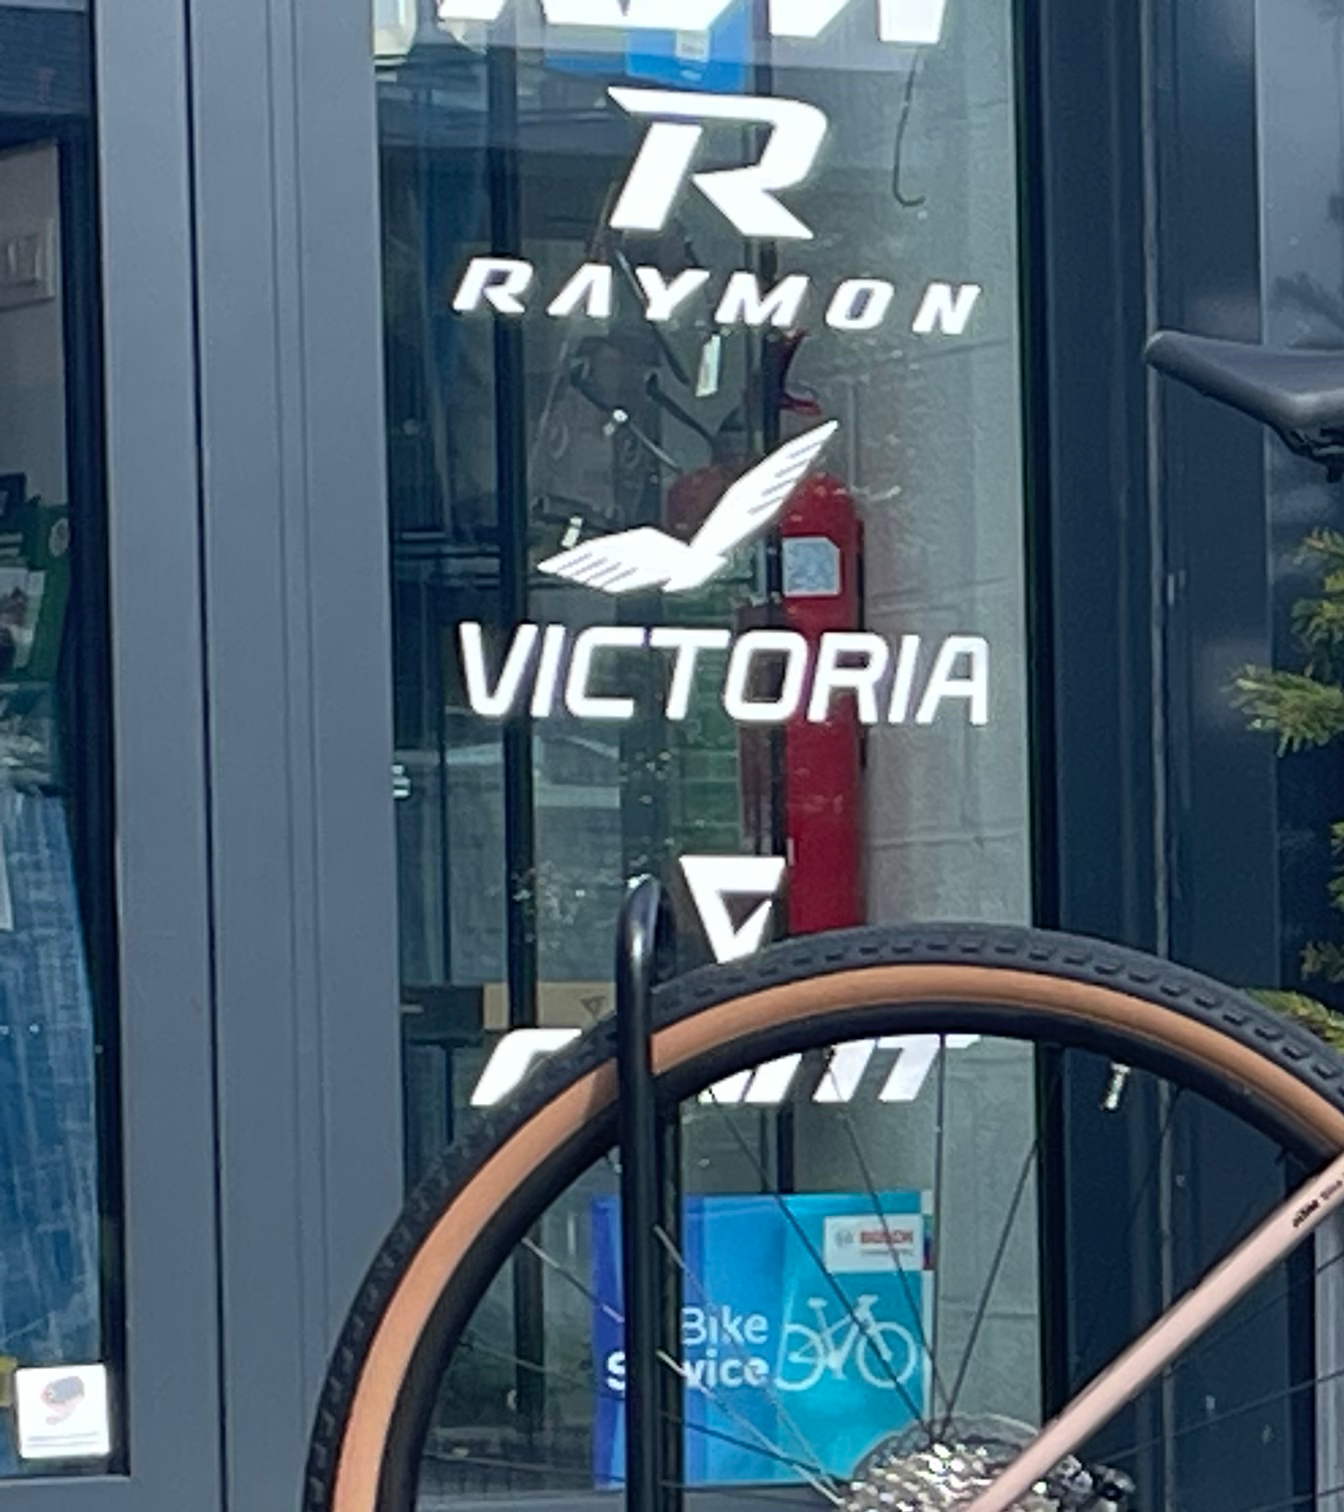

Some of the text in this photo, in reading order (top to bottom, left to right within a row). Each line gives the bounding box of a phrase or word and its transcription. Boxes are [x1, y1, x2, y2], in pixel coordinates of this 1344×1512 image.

[609, 87, 827, 239] R
[453, 258, 982, 335] RAYMON
[460, 623, 989, 725] VICTORIA
[606, 1348, 770, 1391] Svice
